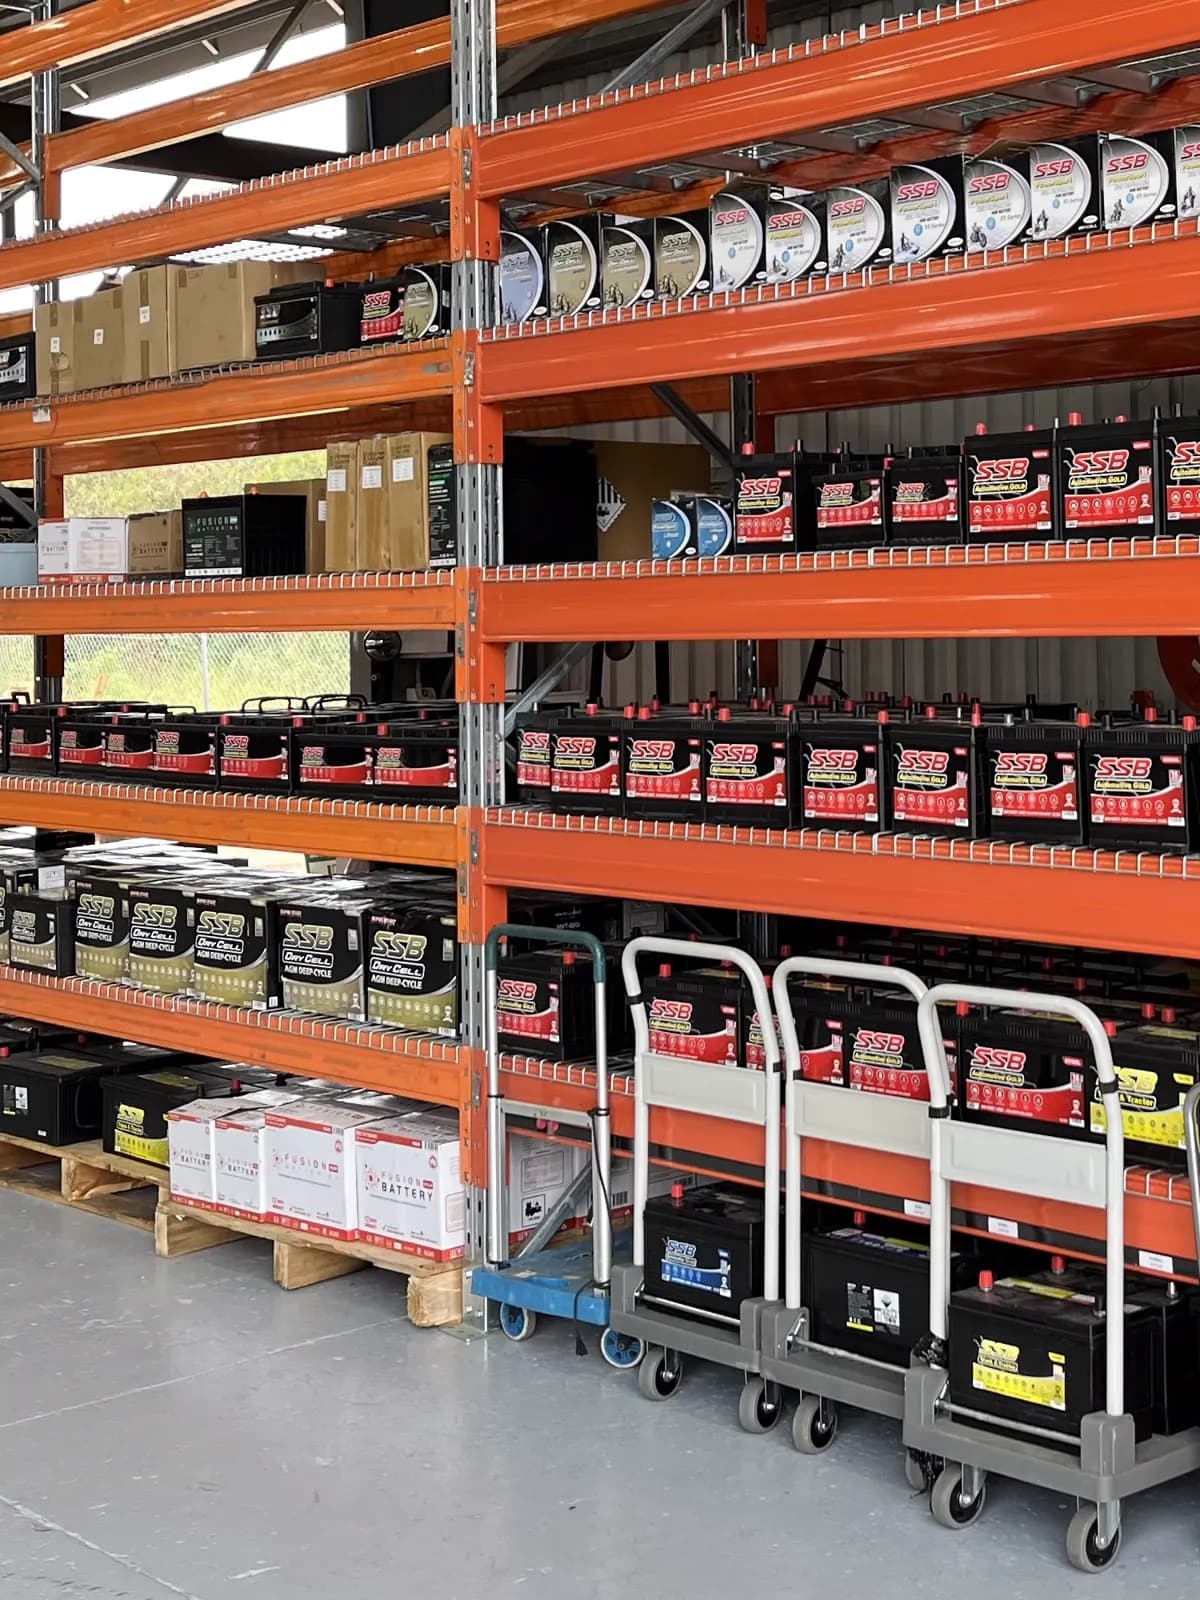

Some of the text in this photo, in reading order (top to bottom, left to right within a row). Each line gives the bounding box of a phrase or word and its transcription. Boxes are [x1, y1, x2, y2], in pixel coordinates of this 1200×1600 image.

[1034, 159, 1073, 178] SSB
[1107, 154, 1149, 172] SSB
[897, 181, 939, 201] SSB
[969, 173, 1010, 193] SSB
[831, 198, 865, 216] SSB
[716, 210, 747, 226] SSB
[769, 211, 803, 229] SSB
[974, 458, 1029, 481] SSB
[1070, 449, 1129, 474] SSB
[739, 477, 781, 498] SSB
[822, 482, 853, 497] SSB
[897, 482, 924, 496] SSB
[522, 732, 550, 750] SS
[554, 737, 596, 755] SSB
[631, 741, 675, 760] SSB
[711, 744, 758, 764] SSB
[809, 749, 858, 770] SSB
[900, 750, 949, 772] SSB
[996, 753, 1047, 773] SSB
[1095, 757, 1152, 779] SSB
[77, 893, 115, 917] SSB
[132, 903, 178, 927] SSB
[197, 910, 245, 937] SSB
[283, 922, 334, 951] SSB
[371, 931, 427, 962] SSB
[498, 980, 537, 1001] SSB
[650, 1000, 692, 1021] SSB
[853, 1030, 905, 1054] SSB
[971, 1046, 1026, 1072] SSB
[380, 1171, 422, 1188] FUSION
[381, 1182, 434, 1203] BATTERY
[668, 1241, 697, 1258] SSB
